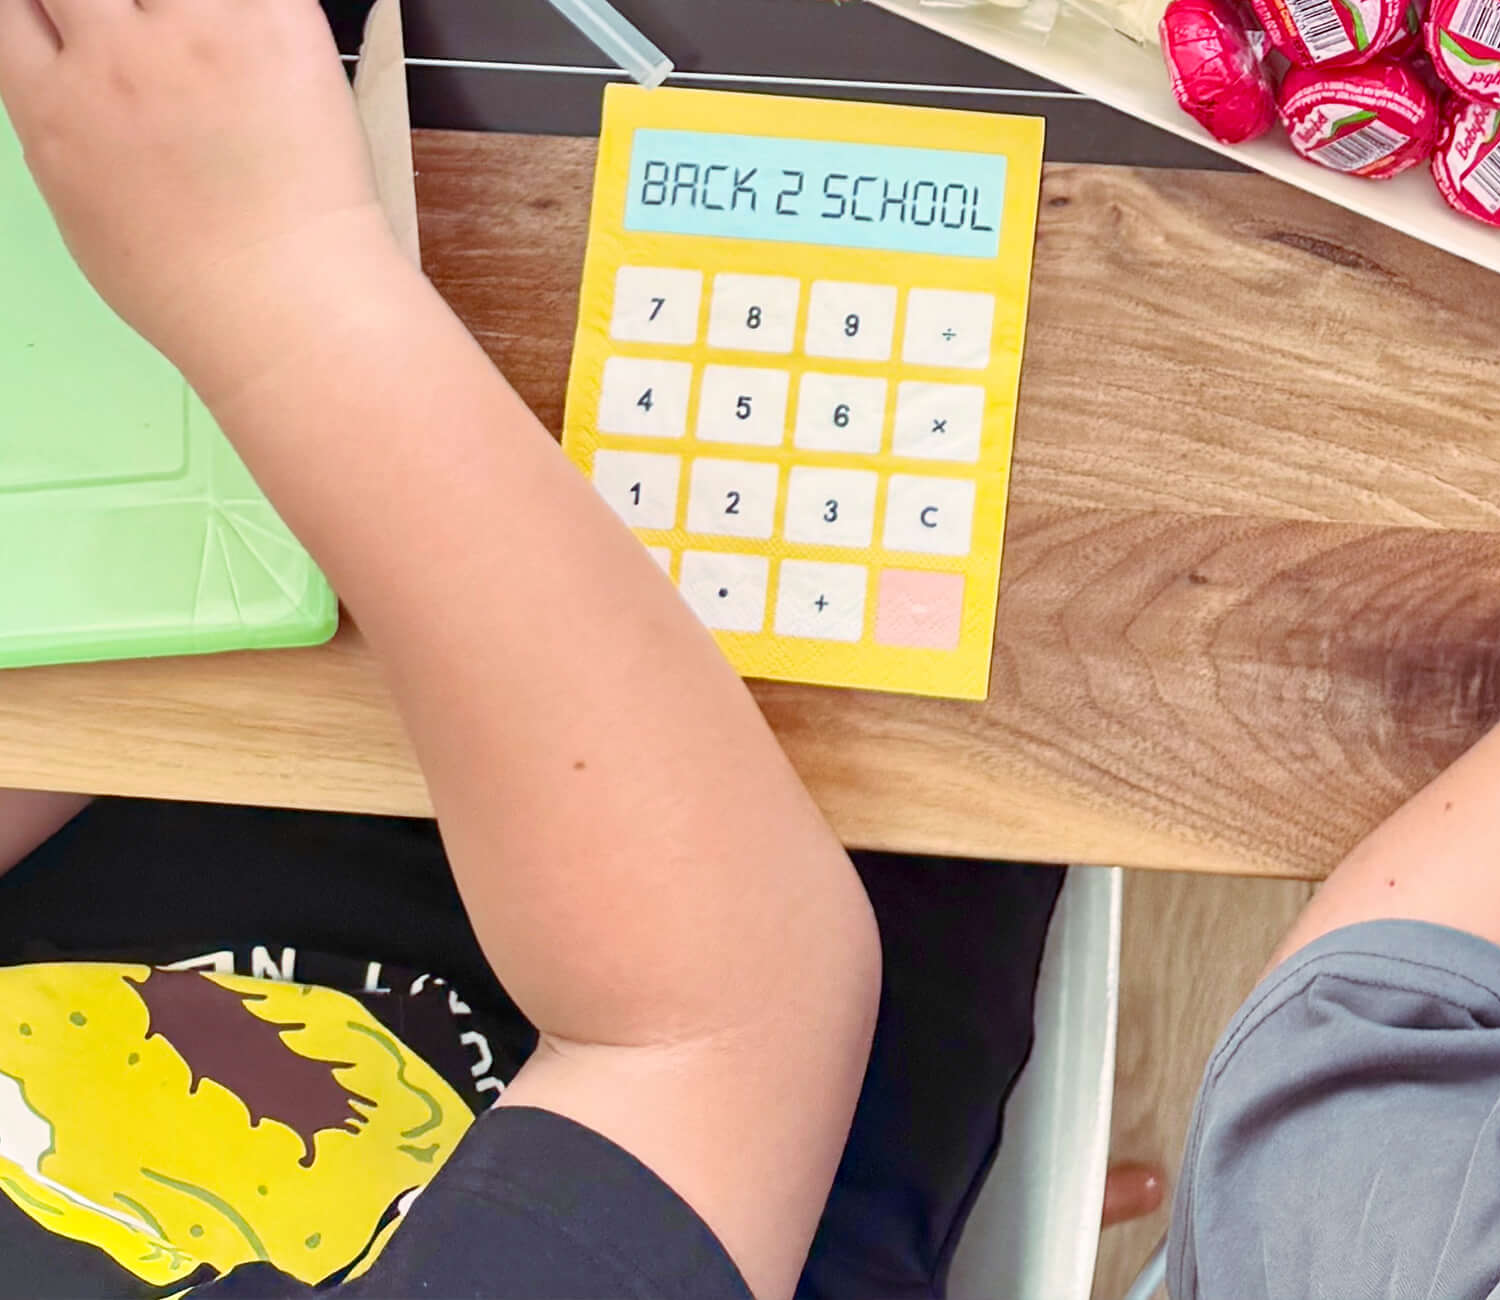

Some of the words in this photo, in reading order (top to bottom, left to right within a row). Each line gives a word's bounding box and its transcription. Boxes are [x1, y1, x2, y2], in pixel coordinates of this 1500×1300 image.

[641, 161, 758, 215] BACK
[776, 170, 805, 217] 2
[821, 174, 994, 233] SCHOOL
[649, 297, 665, 321] 7
[746, 306, 762, 330] 8
[844, 314, 860, 337] 9
[636, 388, 653, 412] 4
[735, 396, 752, 420] 5
[833, 404, 850, 428] 6
[630, 482, 641, 506] 1
[725, 491, 740, 515] 2
[823, 499, 838, 523] 3
[920, 506, 939, 529] C
